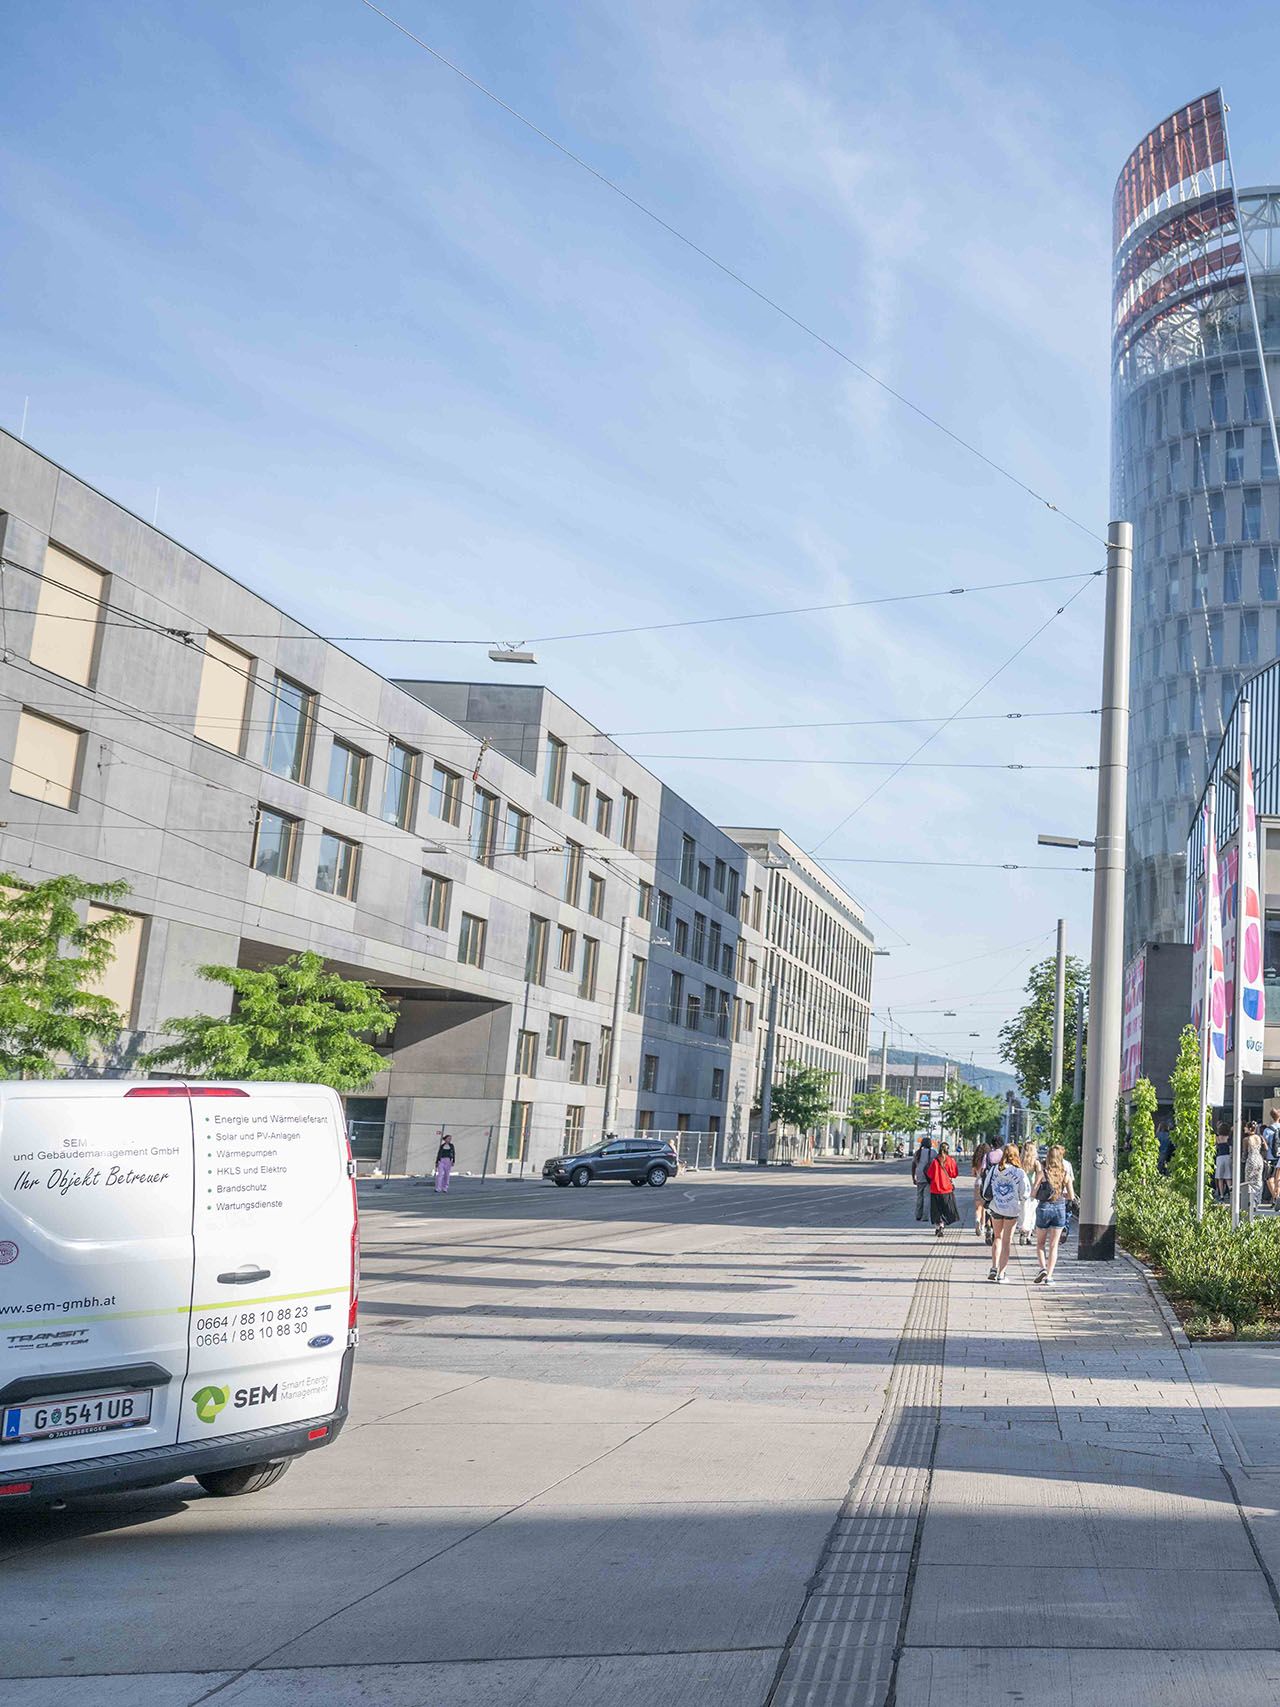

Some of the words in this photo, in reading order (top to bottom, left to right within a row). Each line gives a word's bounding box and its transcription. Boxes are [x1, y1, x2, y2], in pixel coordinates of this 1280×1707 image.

[214, 1115, 249, 1126] Energie
[252, 1115, 268, 1124] und
[216, 1132, 237, 1141] Solar
[240, 1132, 255, 1141] und
[256, 1131, 301, 1142] PV-Anlagen
[13, 1151, 34, 1162] und
[150, 1146, 180, 1156] GmbH
[216, 1166, 241, 1175] HKLS
[243, 1166, 259, 1175] und
[260, 1165, 288, 1174] Elektro
[13, 1170, 41, 1191] Ihr
[47, 1167, 102, 1196] Objekt
[105, 1165, 170, 1187] Betreuer
[216, 1183, 268, 1194] Brandschutz
[216, 1200, 283, 1212] Wartungsdienste
[0, 1295, 116, 1315] ww.sem-gmbh.at
[196, 1315, 228, 1331] 0664
[231, 1314, 238, 1328] /
[239, 1312, 256, 1326] 88
[260, 1310, 274, 1323] 10
[277, 1308, 292, 1321] 88
[294, 1306, 309, 1319] 23
[7, 1328, 90, 1343] TRANSIT
[196, 1332, 228, 1348] 0664
[231, 1330, 236, 1344] /
[239, 1328, 255, 1342] 88
[259, 1326, 273, 1339] 10
[276, 1323, 291, 1337] 88
[294, 1321, 308, 1334] 30
[35, 1338, 89, 1349] CUSTOM
[233, 1383, 279, 1409] SEM
[34, 1409, 48, 1430] G
[9, 1425, 16, 1433] A
